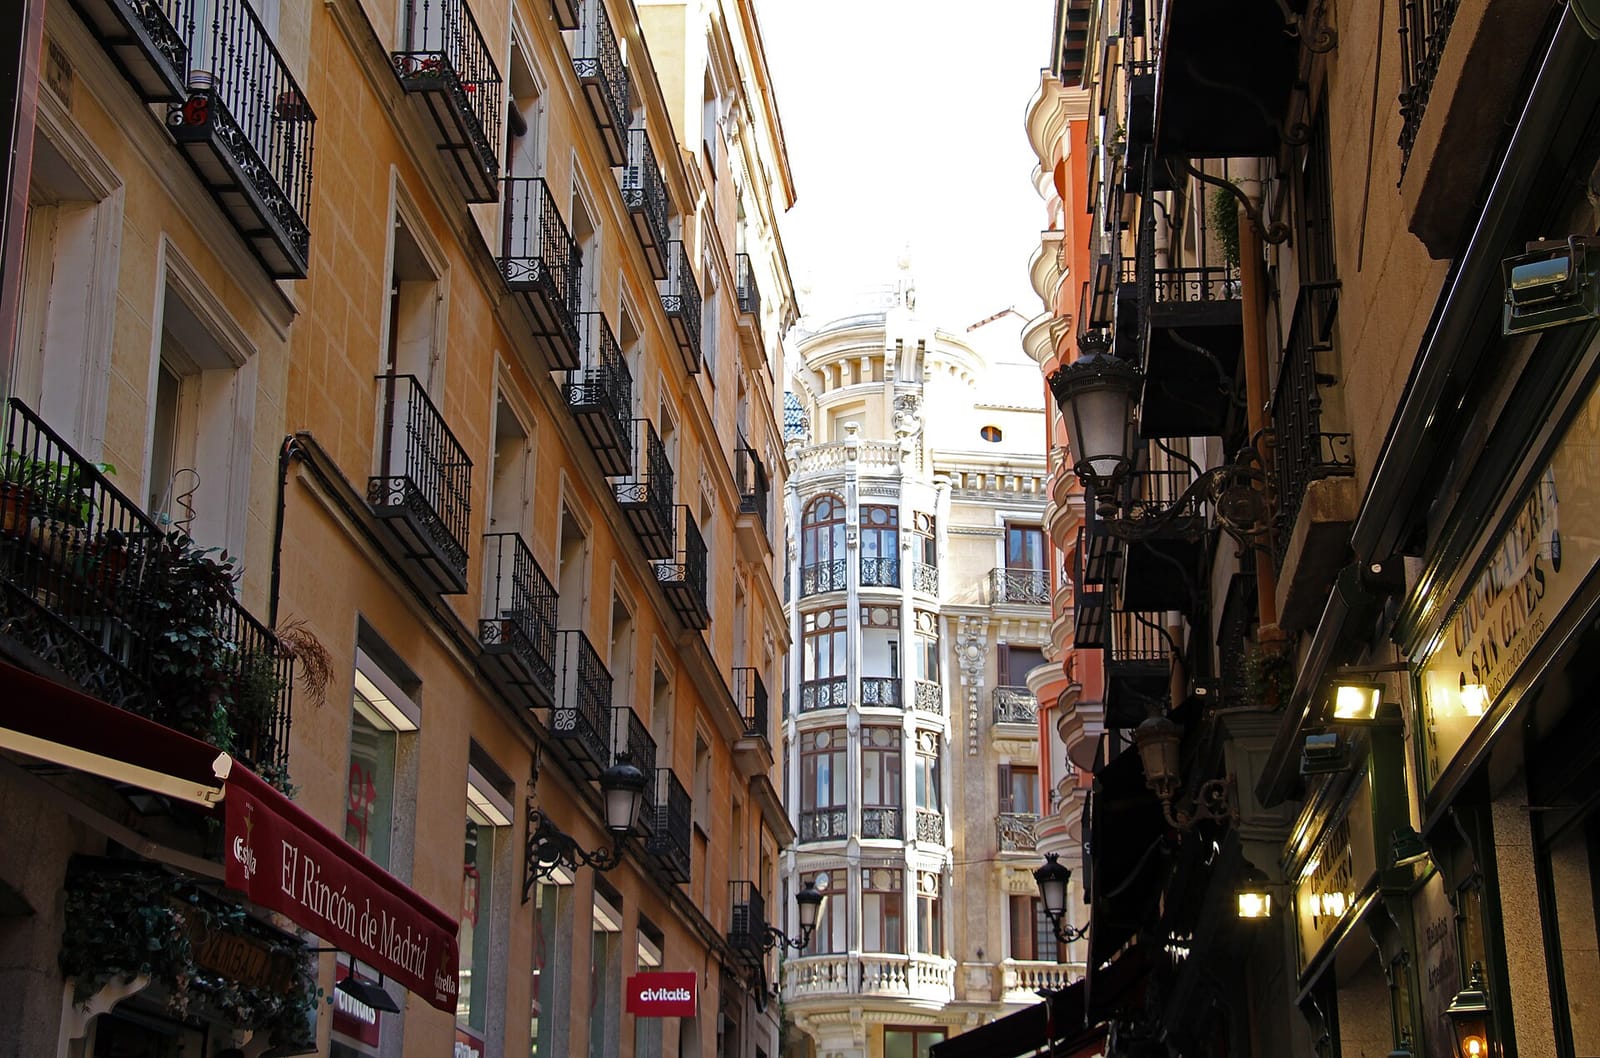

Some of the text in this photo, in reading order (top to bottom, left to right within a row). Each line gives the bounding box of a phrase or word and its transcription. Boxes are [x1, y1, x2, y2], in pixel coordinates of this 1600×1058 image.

[1471, 620, 1498, 685] SAN
[281, 839, 429, 981] El Rincón de Madrid
[640, 987, 691, 1001] civitatis
